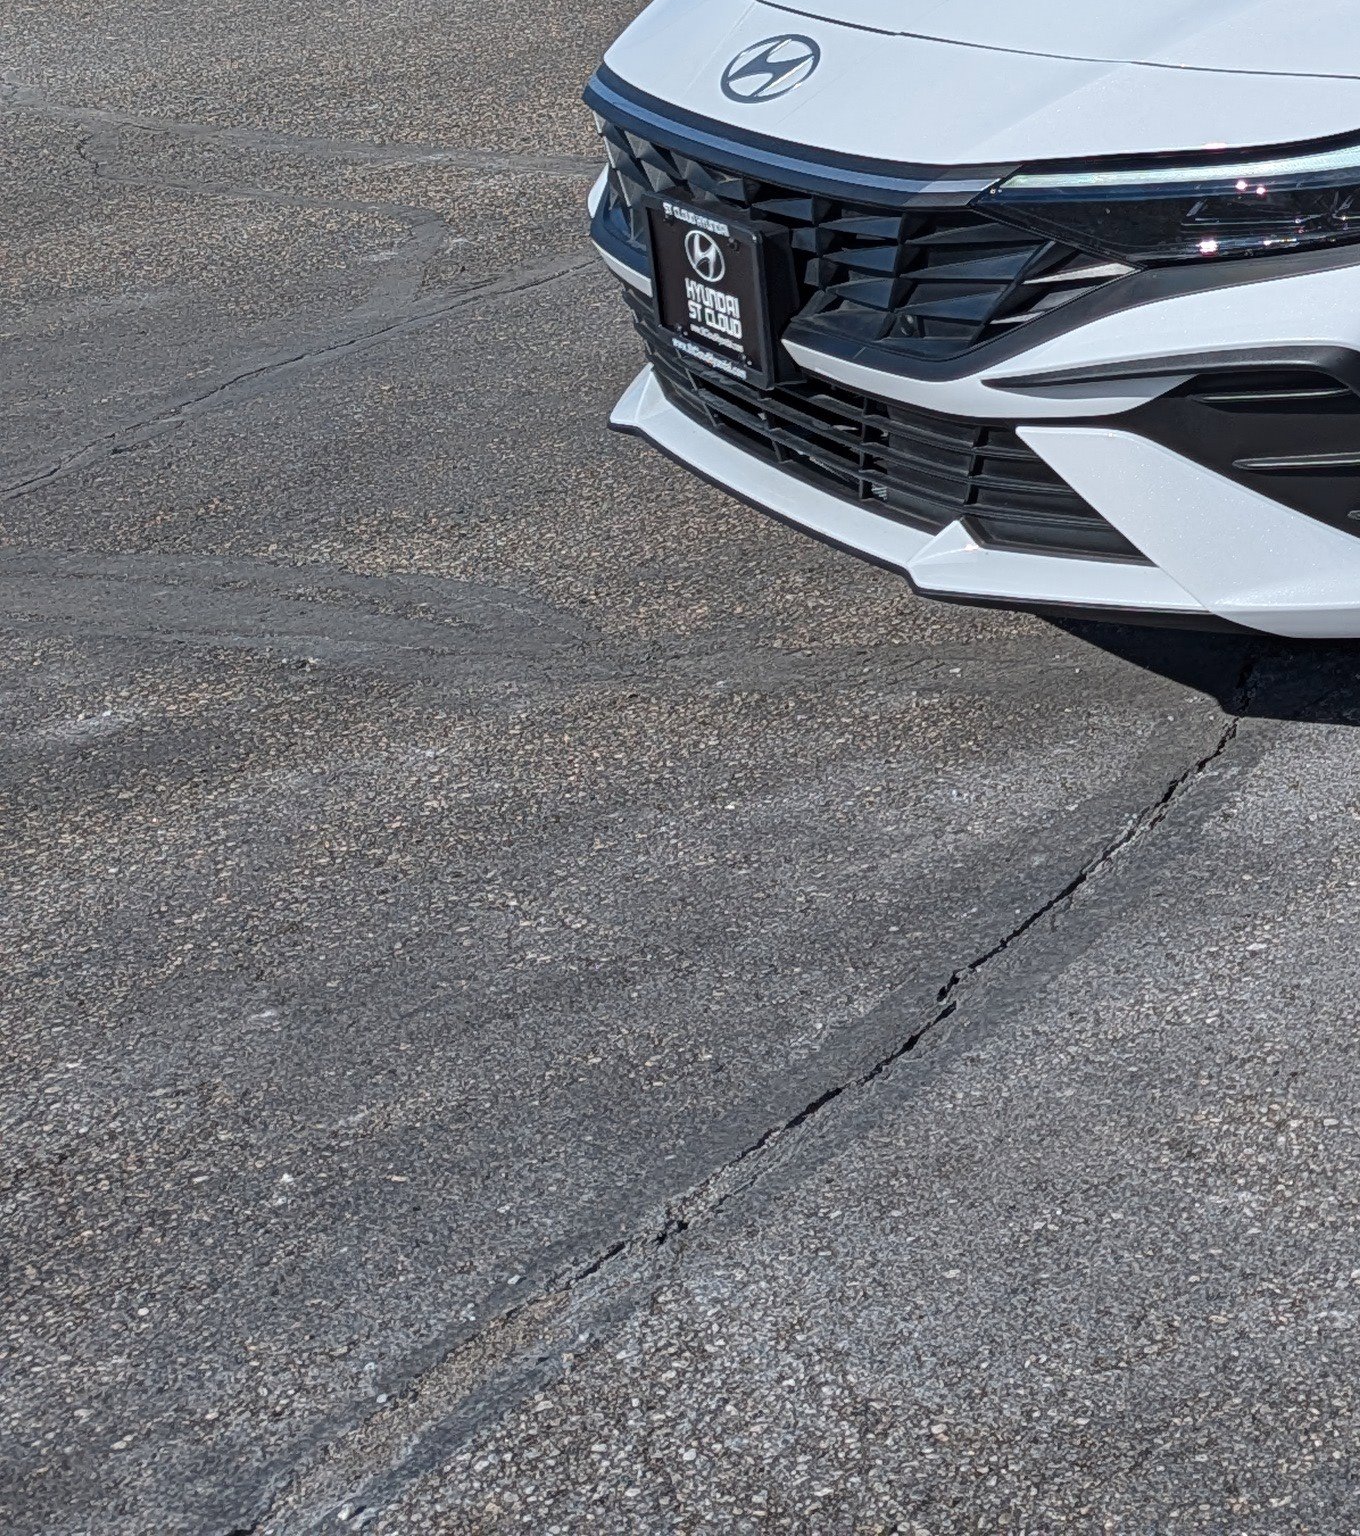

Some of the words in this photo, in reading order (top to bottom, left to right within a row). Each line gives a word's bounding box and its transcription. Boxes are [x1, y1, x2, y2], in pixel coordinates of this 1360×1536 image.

[685, 277, 741, 319] HYUNDAI
[688, 299, 703, 323] ST
[704, 307, 743, 340] CLOUD
